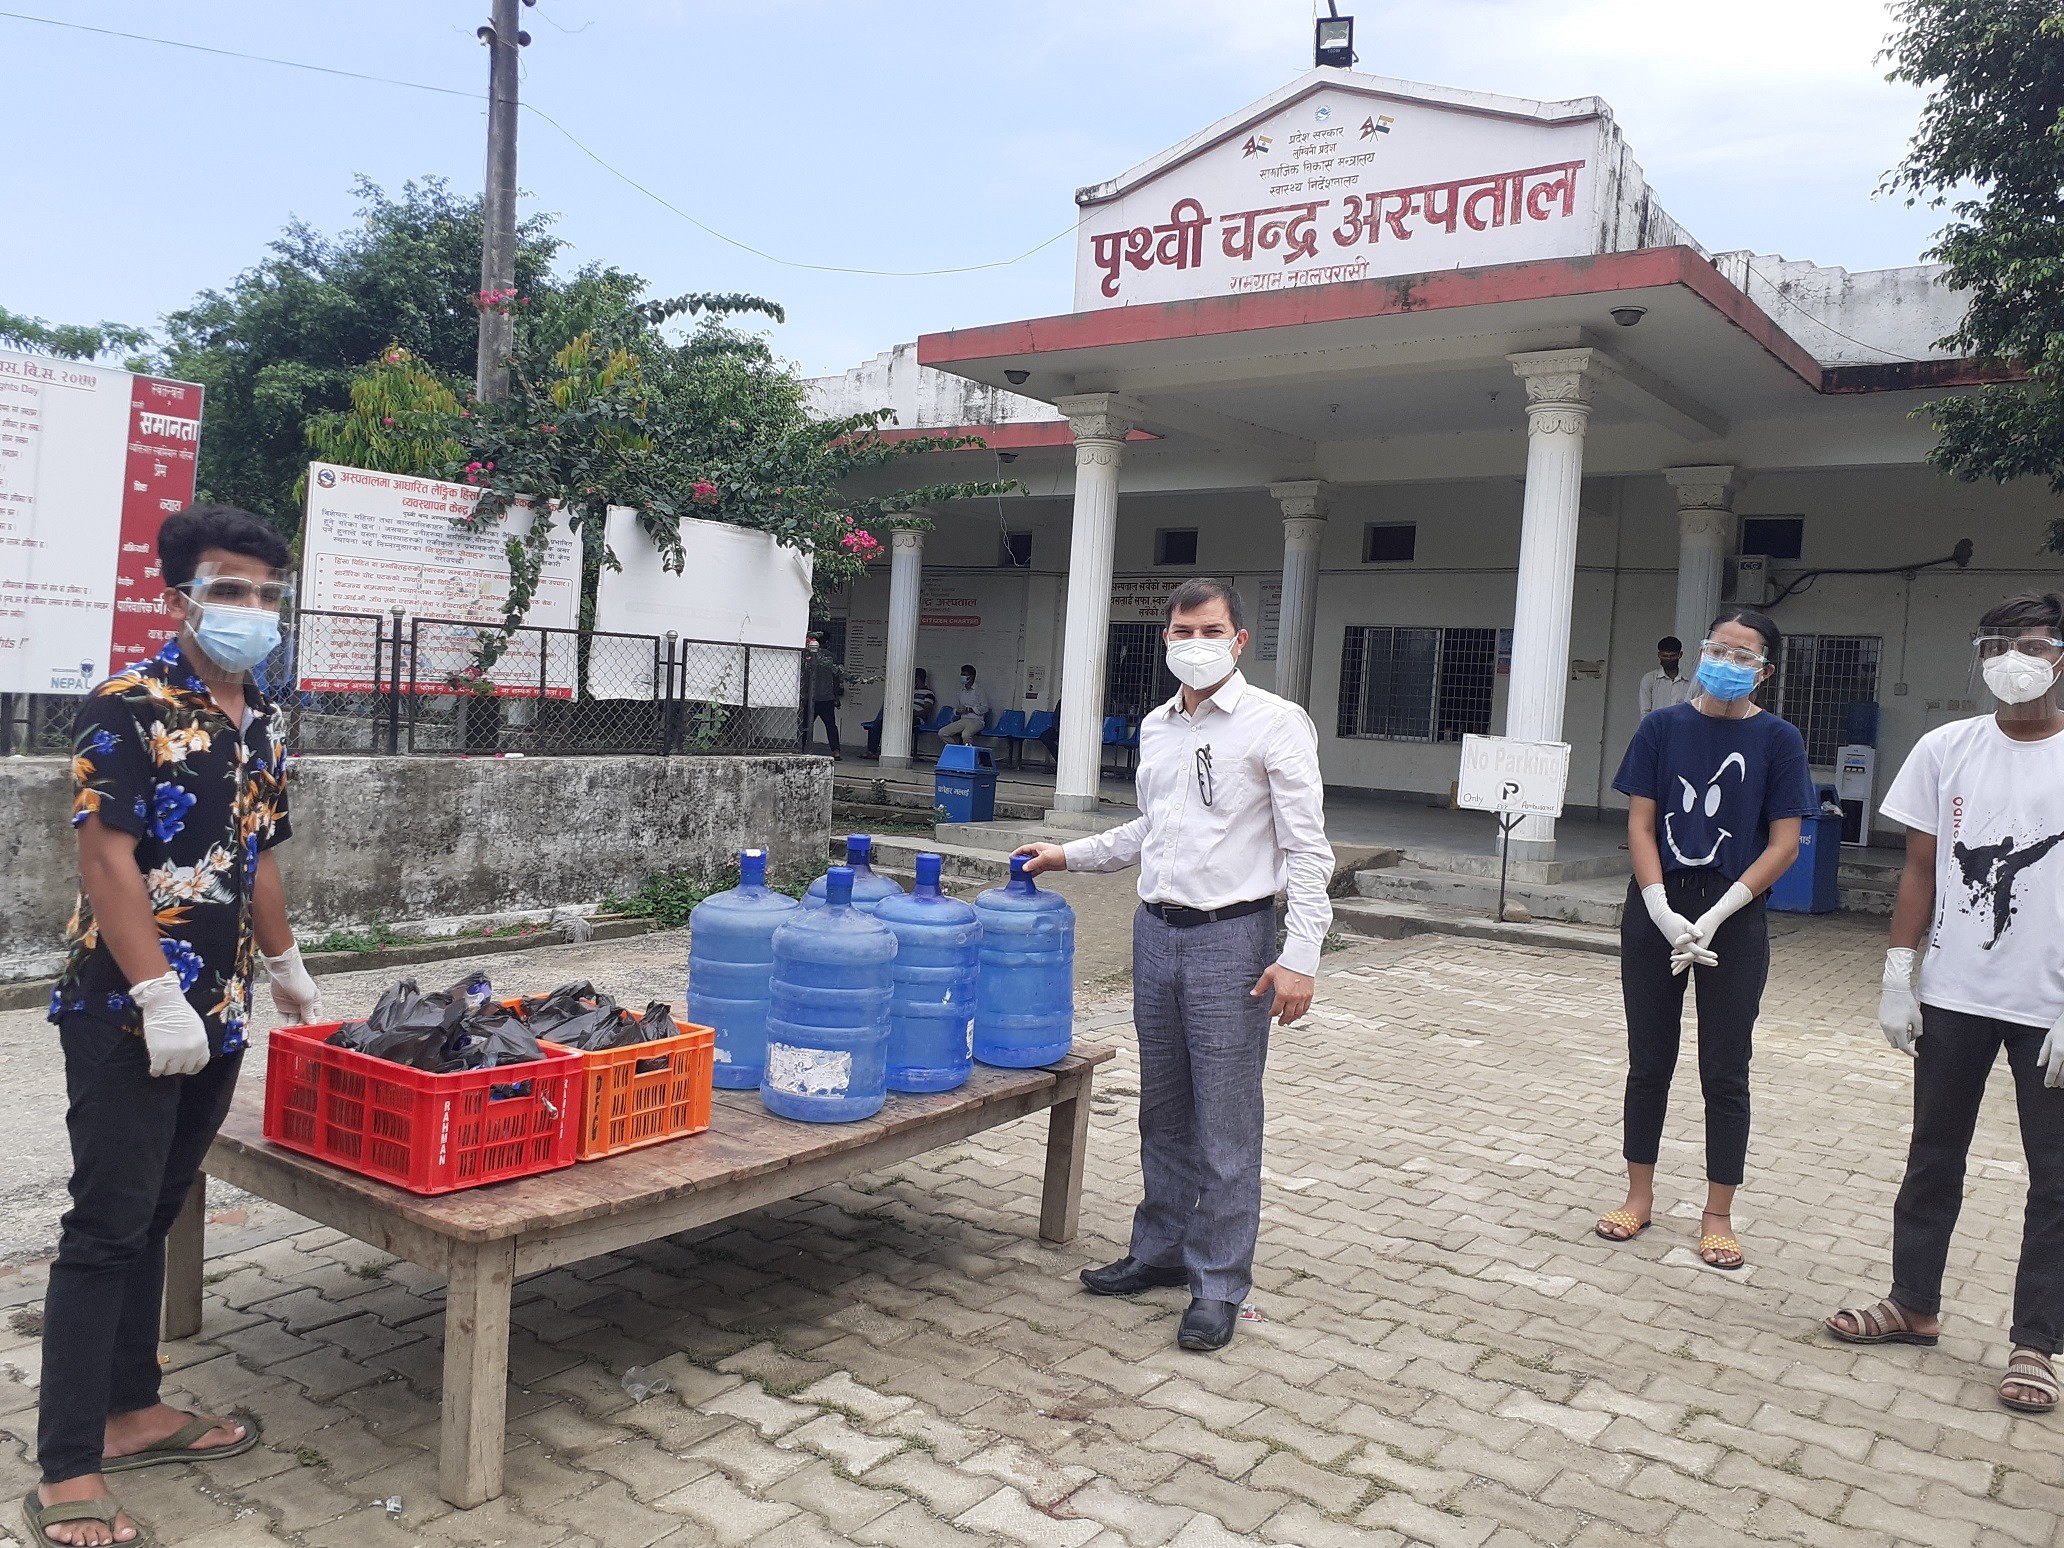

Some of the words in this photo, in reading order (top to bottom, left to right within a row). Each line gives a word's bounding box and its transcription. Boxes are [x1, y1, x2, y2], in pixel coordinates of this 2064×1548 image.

[1288, 129, 1310, 145] प्रदेश
[1313, 126, 1344, 140] सरकार
[1318, 141, 1337, 156] प्रदेश
[1260, 163, 1299, 181] सामाजिक
[1303, 158, 1334, 174] विकास
[1338, 152, 1376, 167] मन्त्रालय
[1269, 182, 1303, 197] स्वास्थ्य
[1090, 197, 1212, 298] पृथ्वी
[1219, 199, 1330, 265] चन्द्र
[1332, 159, 1586, 247] अस्पताल
[1286, 255, 1371, 287] नवलपरासी
[21, 384, 39, 398] Day
[139, 411, 200, 442] समानता
[340, 471, 390, 488] अस्पतालमा
[159, 498, 183, 512] न्याय
[402, 496, 447, 512] व्यवस्थापन
[449, 501, 469, 516] केन्द्र
[1744, 562, 1759, 570] CG
[936, 598, 978, 608] अस्पताल
[50, 677, 91, 690] NEPAL
[1465, 743, 1489, 770] No
[1494, 747, 1560, 782] Parking
[1463, 792, 1484, 806] Only
[438, 1100, 451, 1166] RAHMAN
